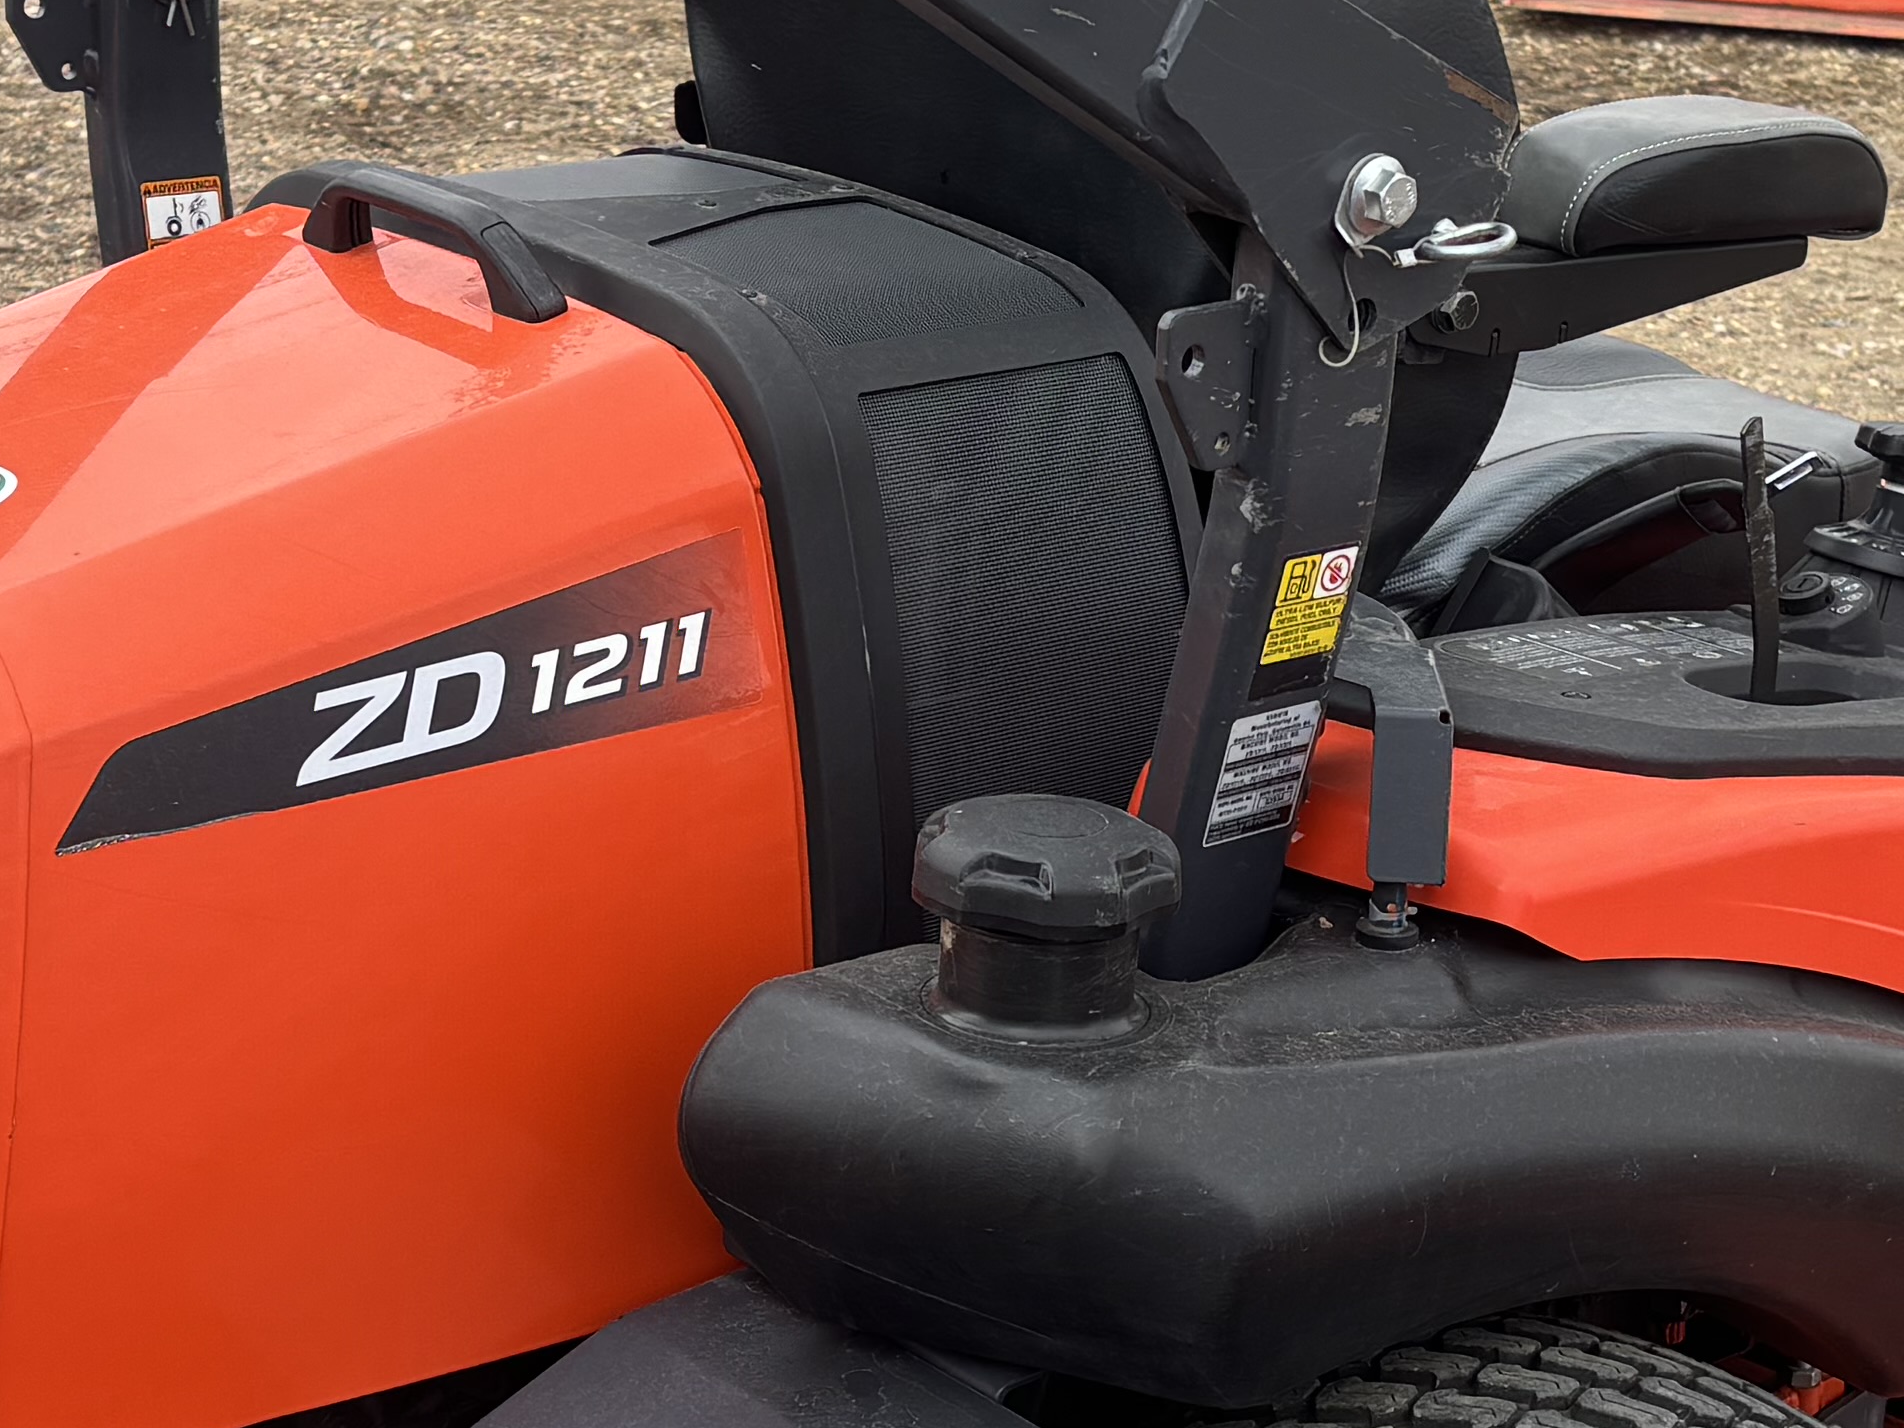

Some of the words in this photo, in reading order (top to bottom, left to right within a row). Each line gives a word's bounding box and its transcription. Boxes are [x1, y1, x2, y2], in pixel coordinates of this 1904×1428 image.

[152, 178, 219, 194] ADVERTENCIA
[296, 651, 506, 787] ZD
[531, 608, 712, 714] 1211
